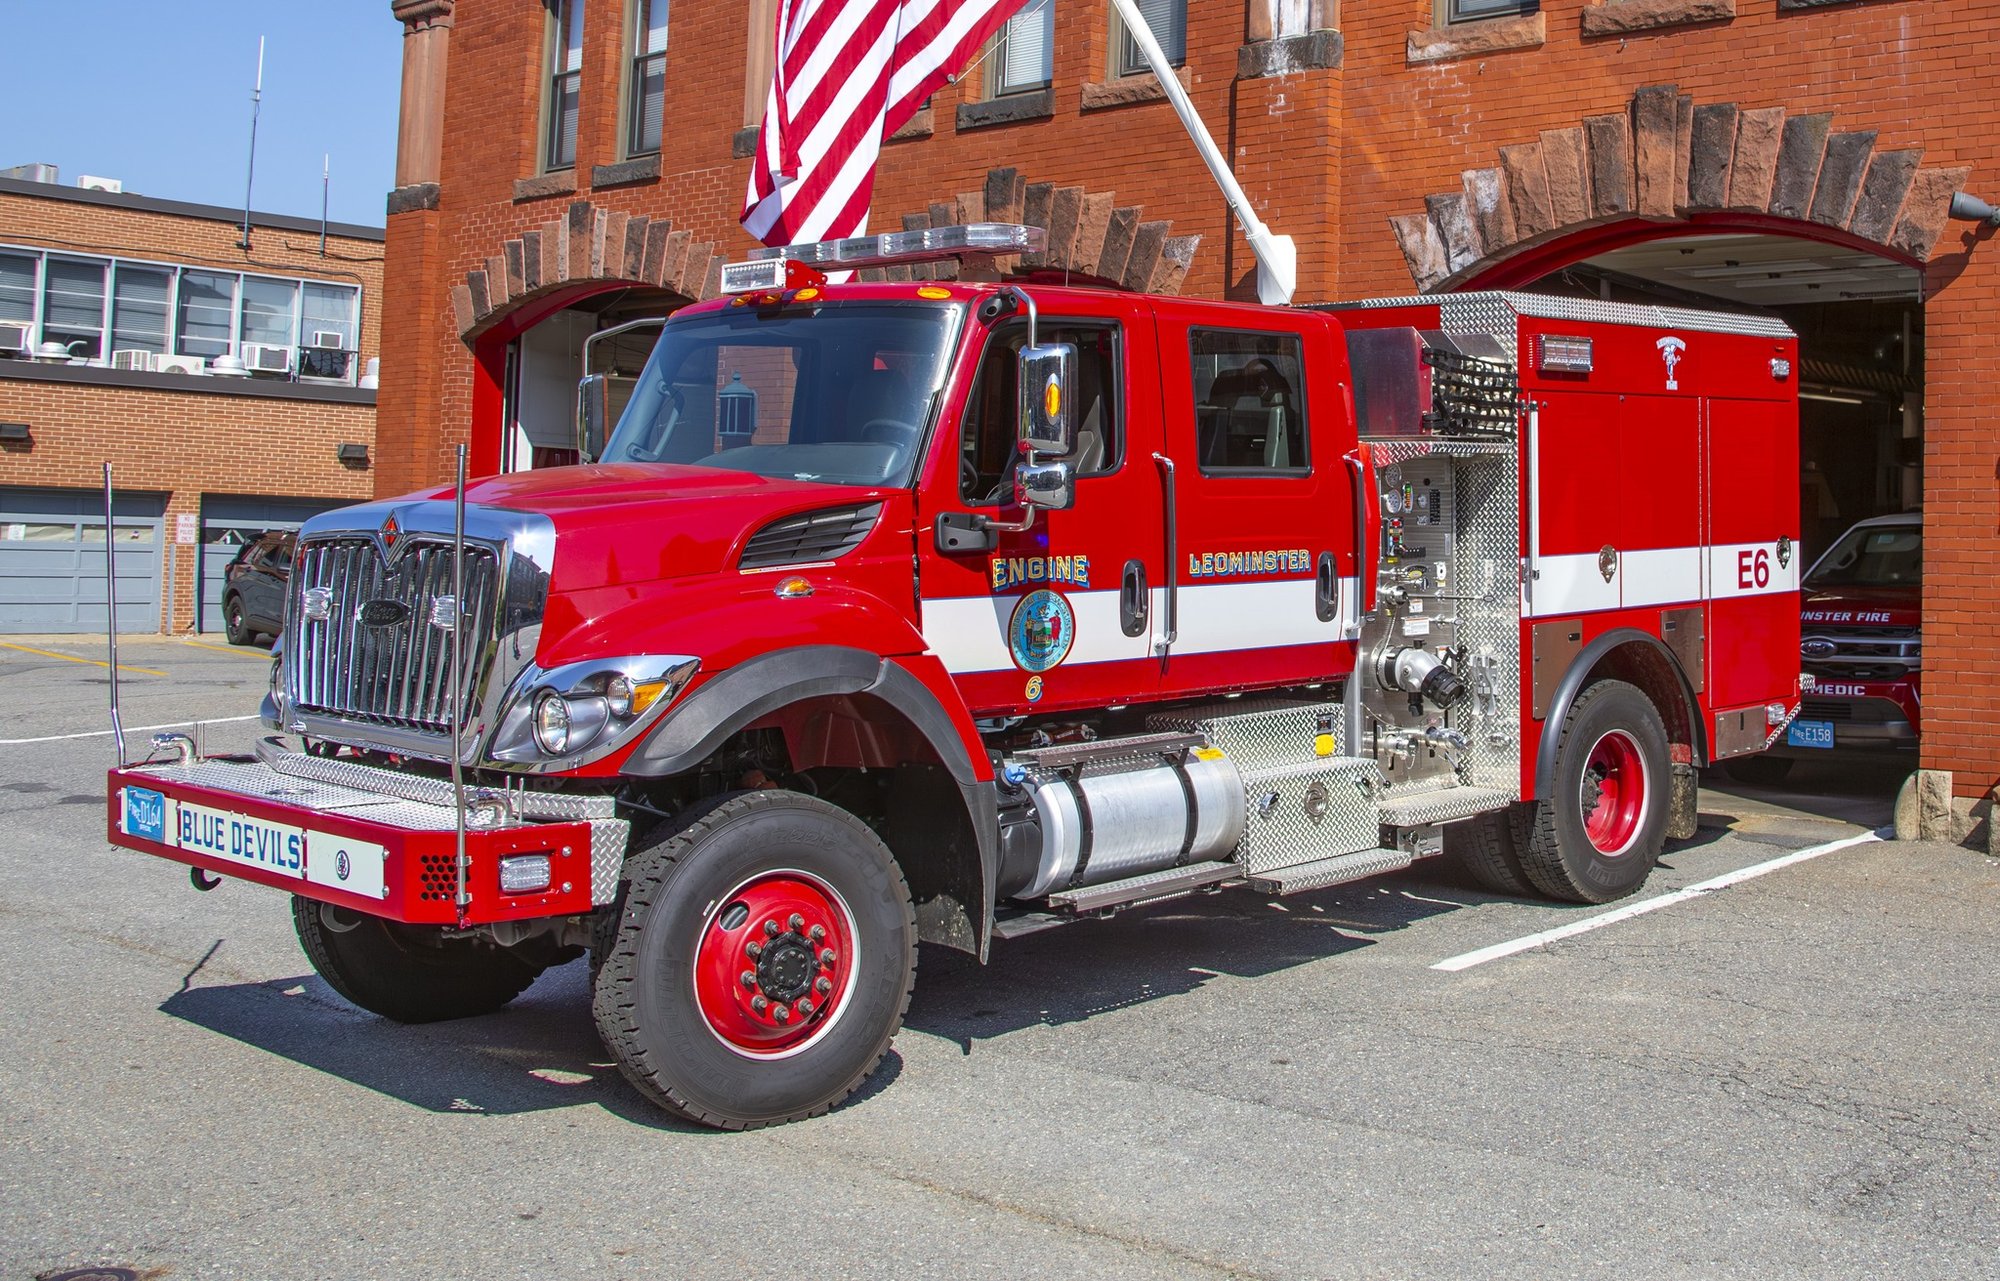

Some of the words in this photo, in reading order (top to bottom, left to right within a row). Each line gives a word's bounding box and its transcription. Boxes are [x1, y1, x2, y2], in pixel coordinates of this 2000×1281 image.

[992, 555, 1090, 591] ENGINE
[1189, 549, 1311, 576] LEOMINSTER
[1738, 548, 1769, 589] E6
[1856, 612, 1890, 622] FIRE
[1025, 675, 1043, 702] 6
[1804, 684, 1865, 696] MEDIC
[1805, 728, 1830, 742] E158
[141, 800, 160, 829] D164
[183, 810, 224, 851] BLUE
[231, 821, 300, 870] DEVILS
